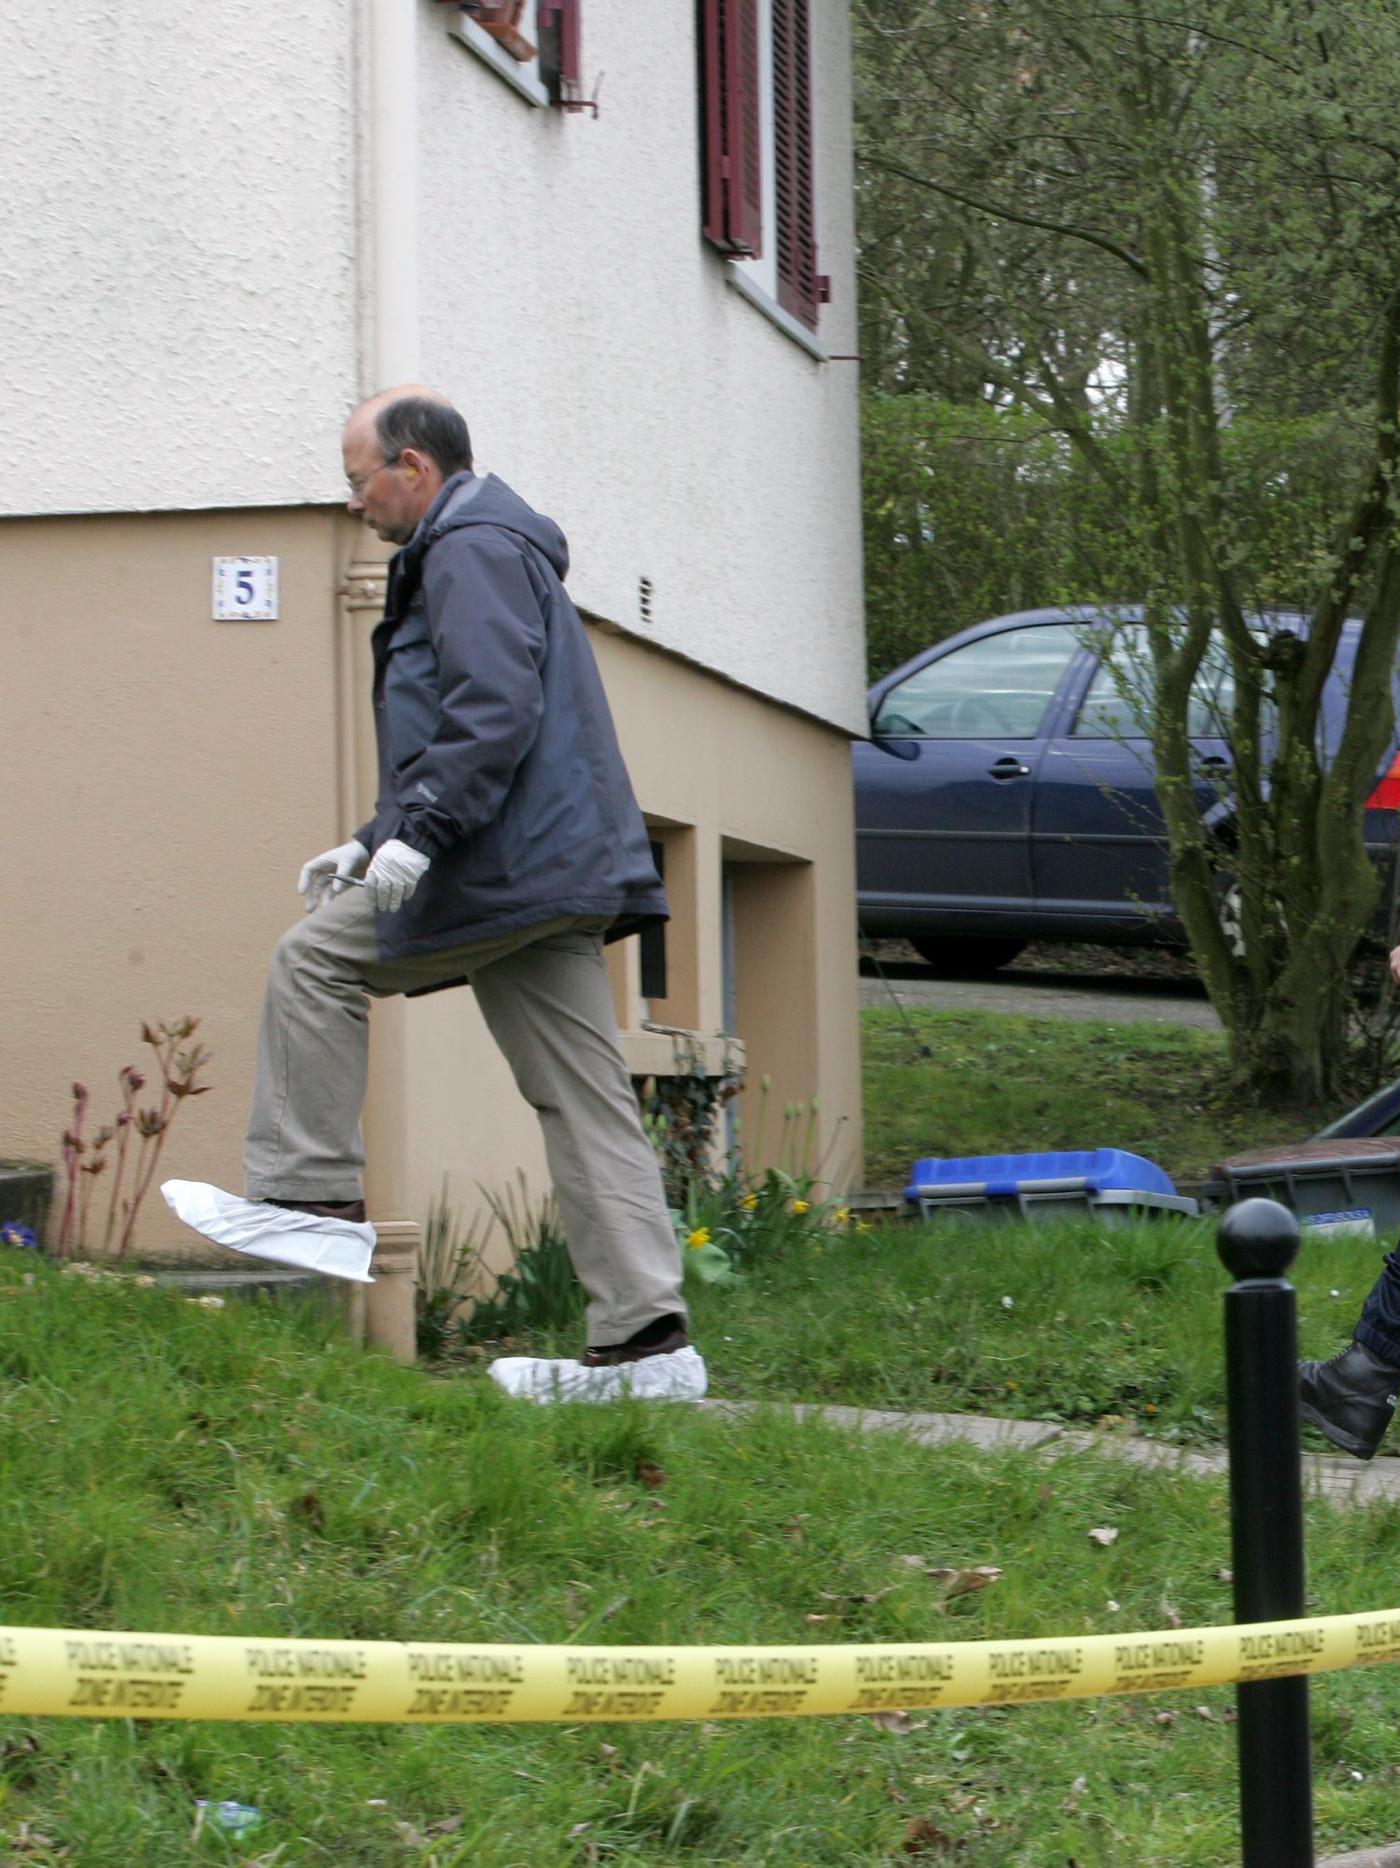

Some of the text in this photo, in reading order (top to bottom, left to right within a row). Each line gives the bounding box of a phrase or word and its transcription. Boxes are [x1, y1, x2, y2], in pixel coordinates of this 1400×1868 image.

[235, 570, 254, 605] 5
[66, 1641, 194, 1675] POLICE NATIONALE
[1114, 1640, 1204, 1671] POLICE NATIONALE
[1239, 1634, 1274, 1661] POLICE
[1275, 1628, 1325, 1656] NATIONALE
[245, 1648, 367, 1680] POLICE NATIONALE
[407, 1653, 524, 1684] POLICE NATIONALE
[566, 1656, 675, 1686] POLICE NATIONALE
[714, 1657, 817, 1686] POLICE NATIONALE
[855, 1654, 953, 1683] POLICE NATIONALE
[988, 1648, 1083, 1679] POLICE NATIONALE
